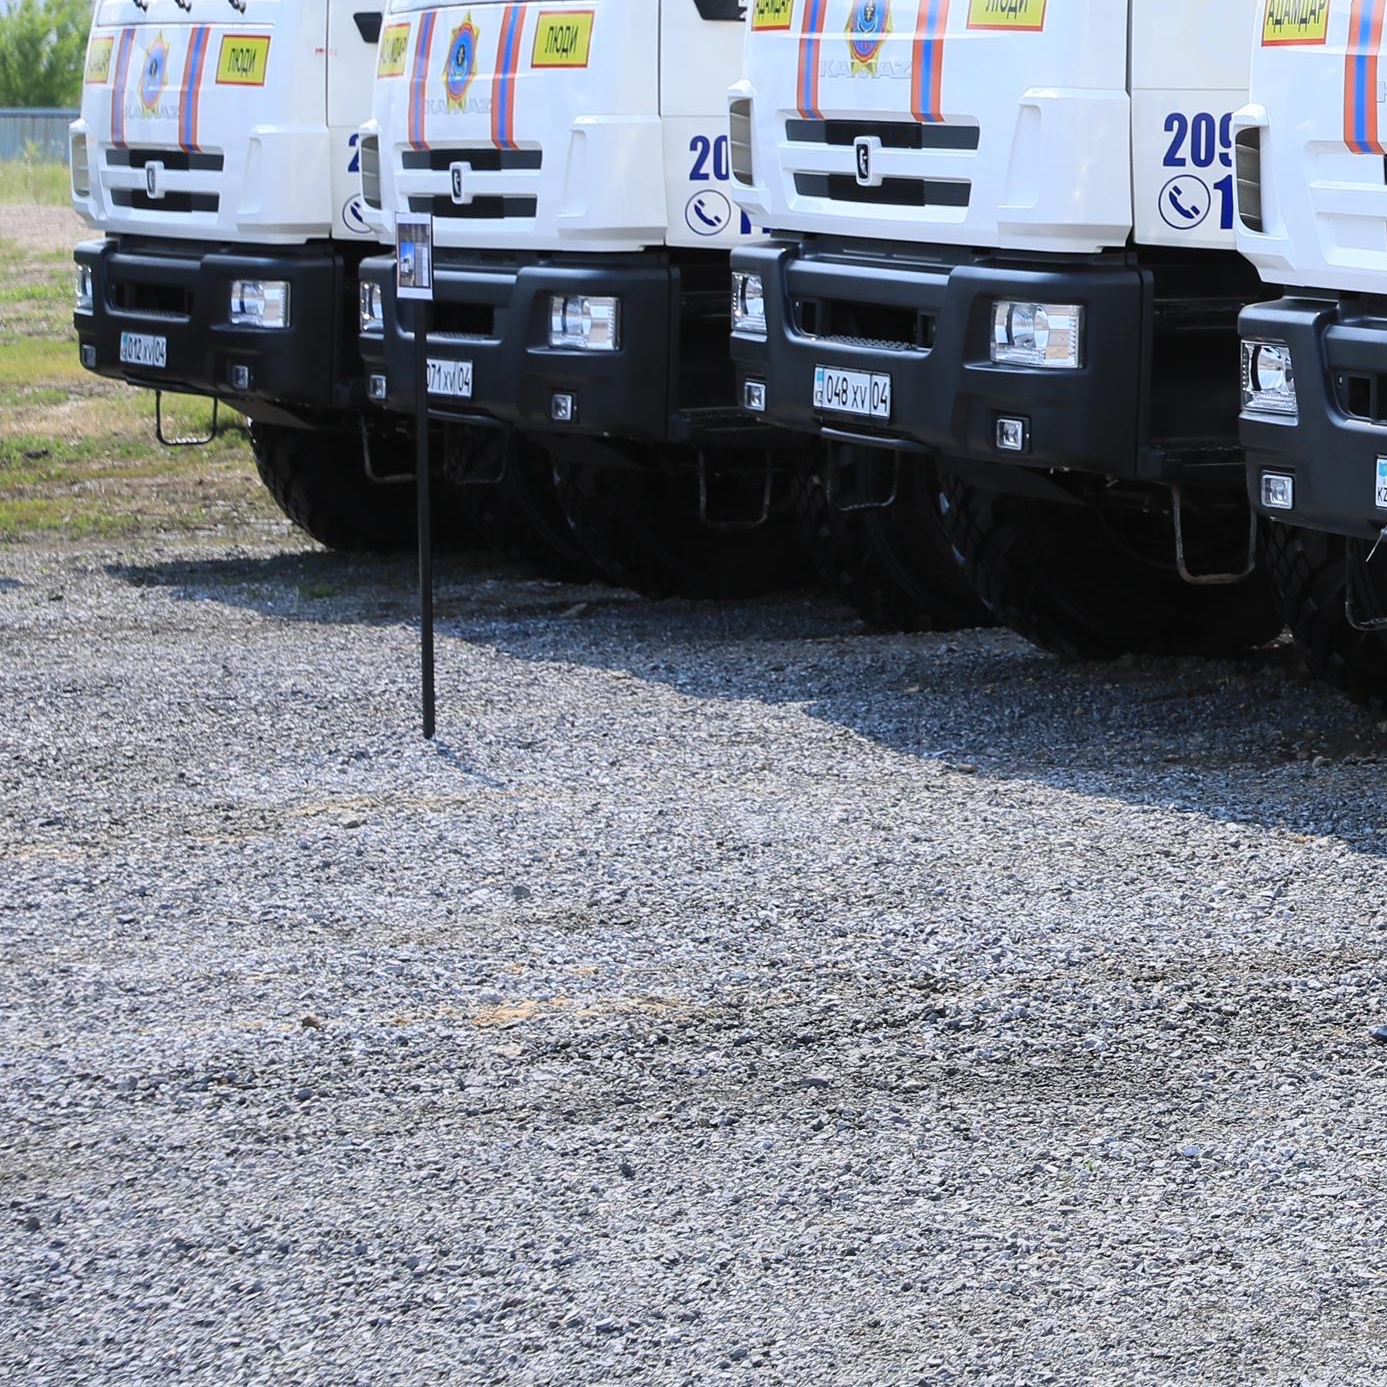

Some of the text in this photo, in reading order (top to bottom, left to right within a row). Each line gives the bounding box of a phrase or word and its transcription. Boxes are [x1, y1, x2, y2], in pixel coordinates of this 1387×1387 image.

[545, 25, 579, 58] ЛЮДИ
[458, 366, 470, 393] 04
[827, 375, 848, 406] 048
[851, 384, 867, 409] XV
[872, 380, 888, 413] 04
